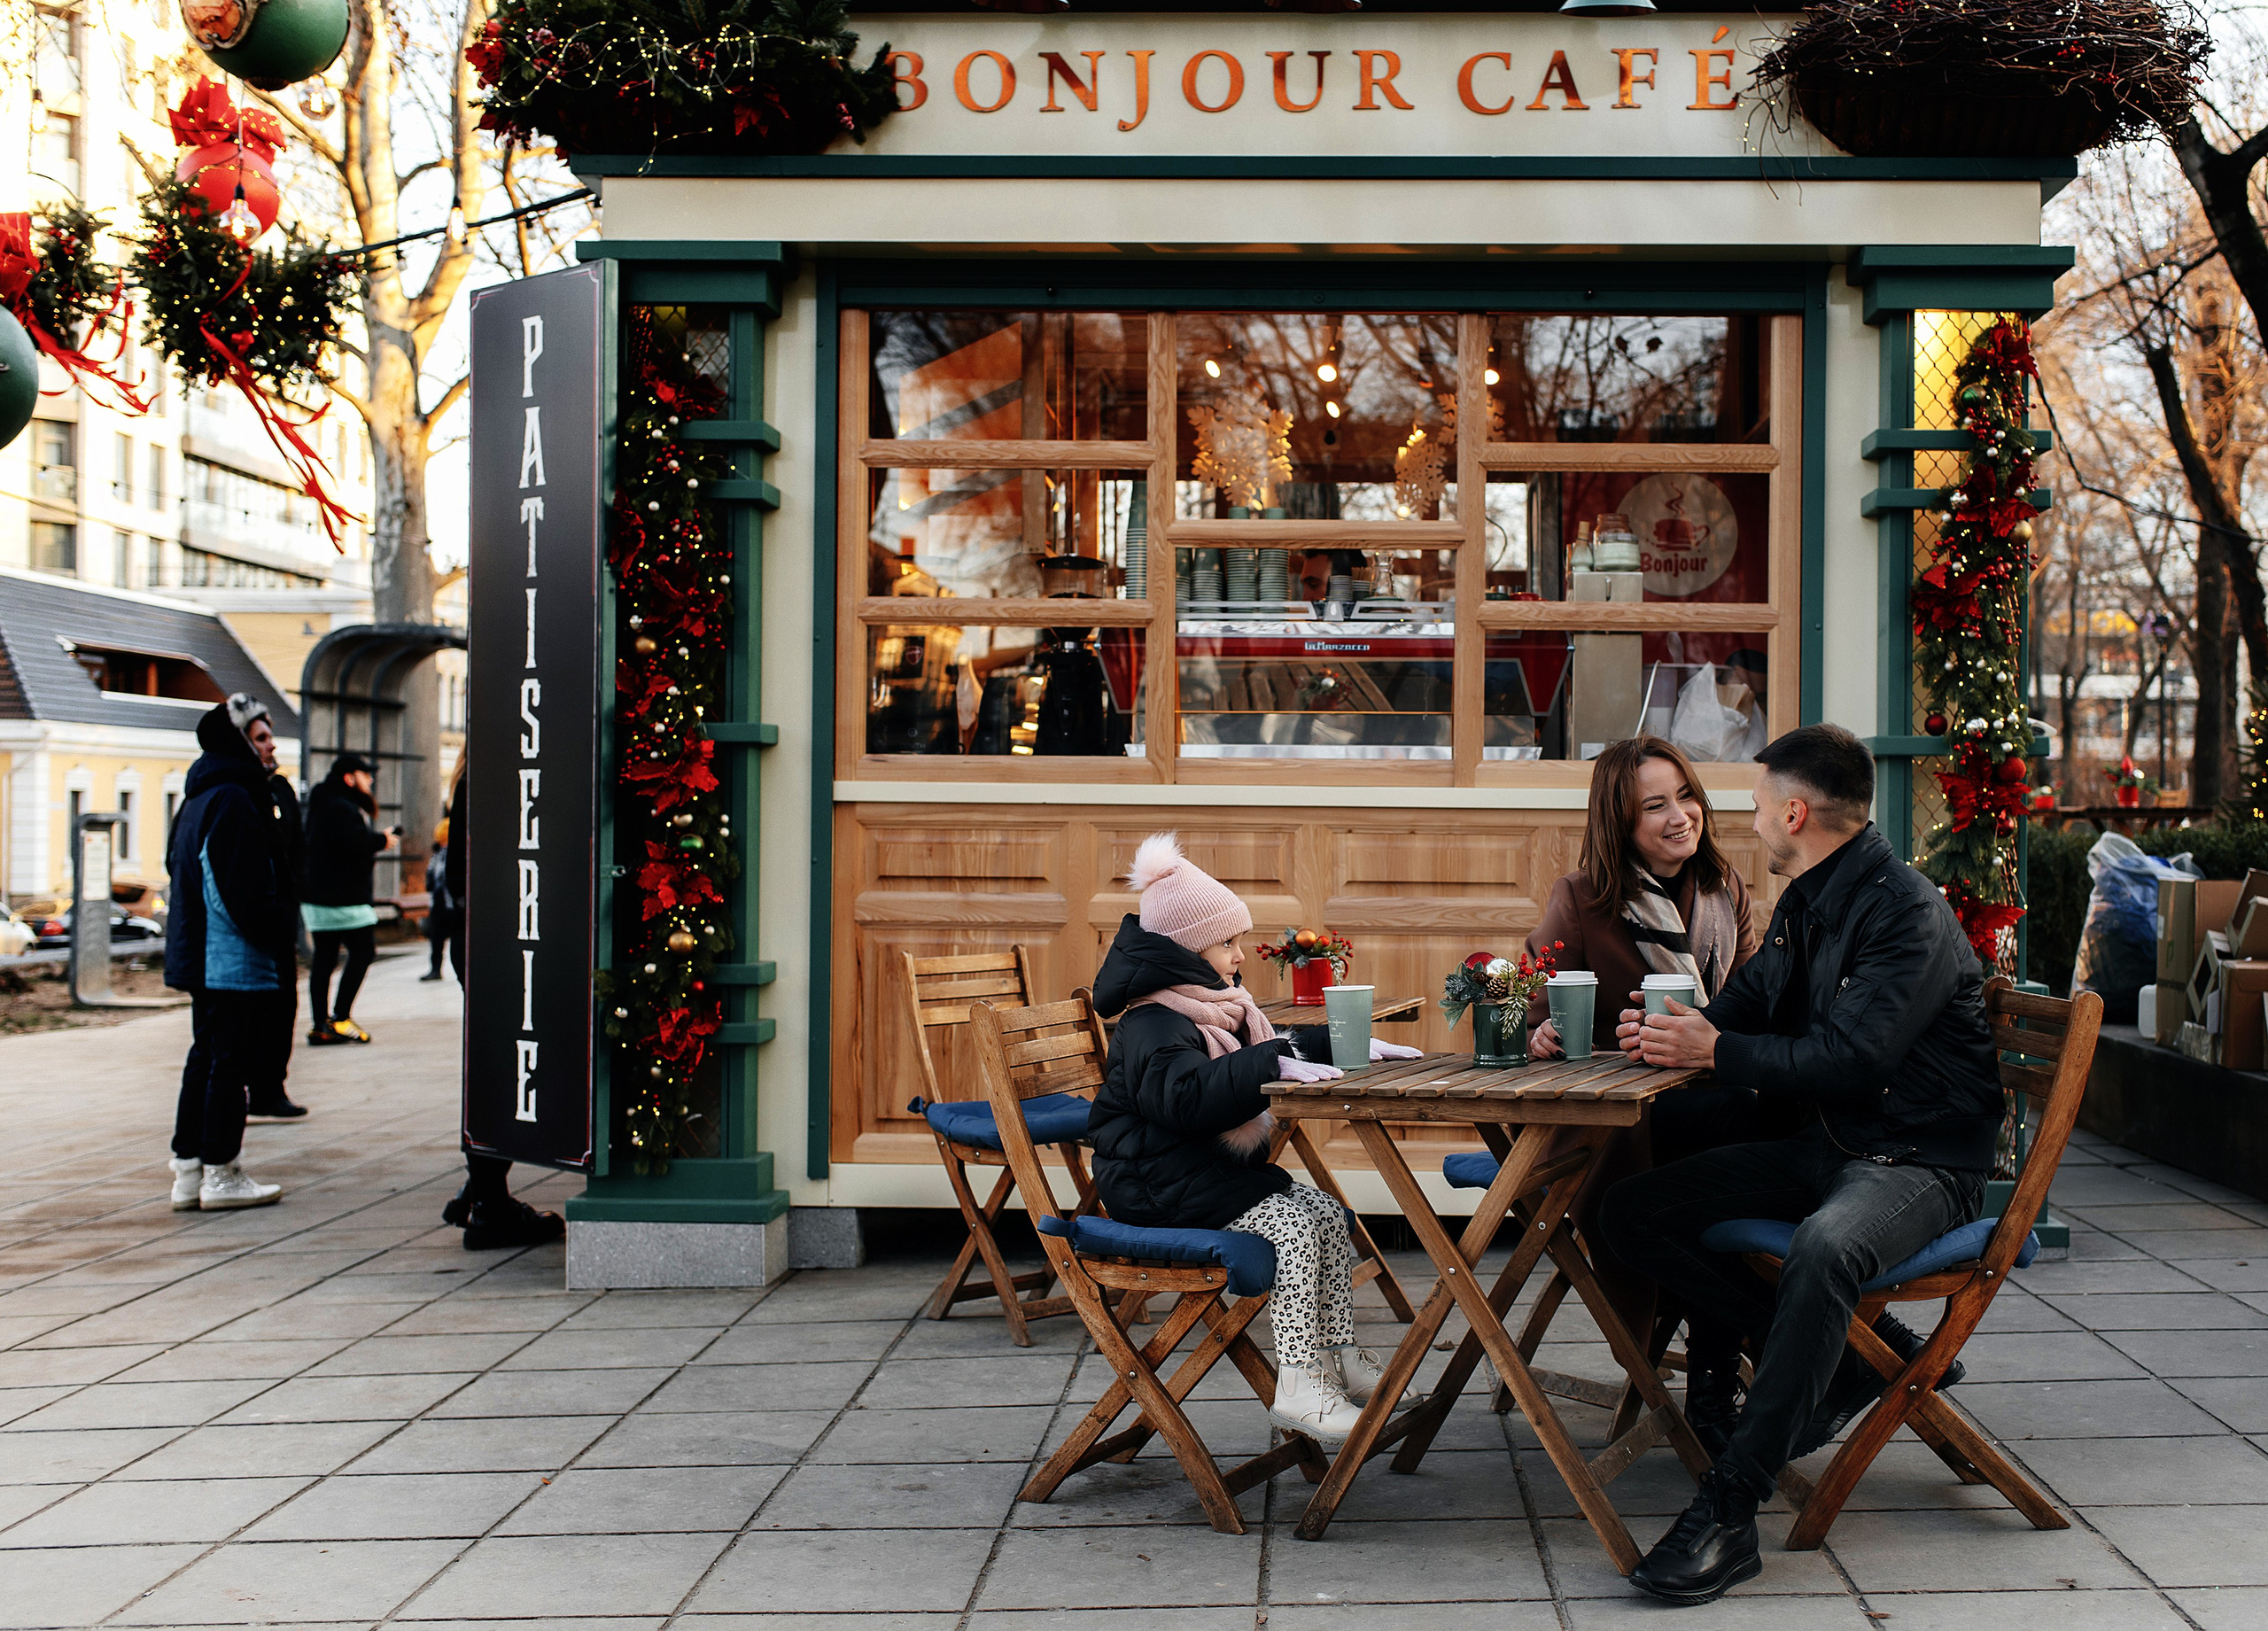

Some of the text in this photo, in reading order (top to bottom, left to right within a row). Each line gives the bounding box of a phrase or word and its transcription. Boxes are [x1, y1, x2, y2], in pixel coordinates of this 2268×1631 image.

[884, 25, 1739, 131] BONJOUR CAFÉ
[1640, 552, 1708, 578] Bonjour
[515, 315, 546, 1122] PATISERIE
